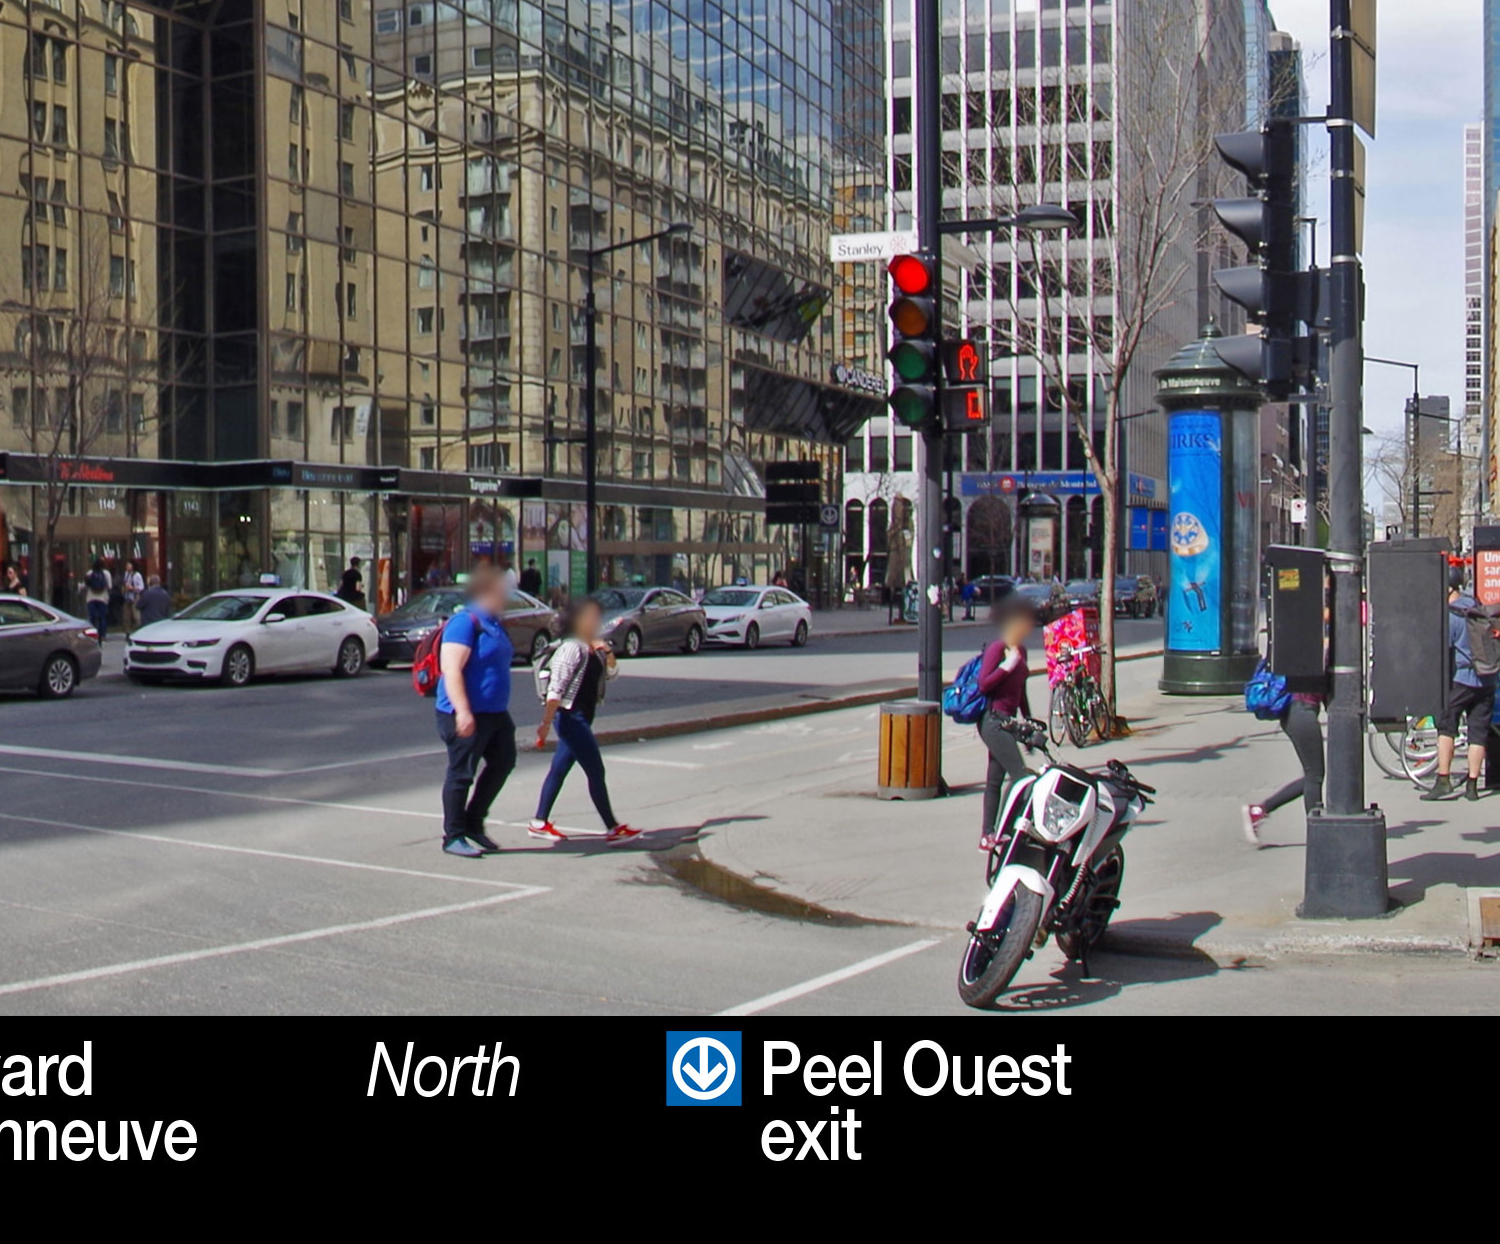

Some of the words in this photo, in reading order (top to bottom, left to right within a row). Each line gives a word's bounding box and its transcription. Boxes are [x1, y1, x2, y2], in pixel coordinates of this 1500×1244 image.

[837, 243, 884, 257] Stanley
[1167, 377, 1221, 388] Maisonneuve
[468, 477, 499, 494] Tangerine
[1484, 590, 1500, 602] qui
